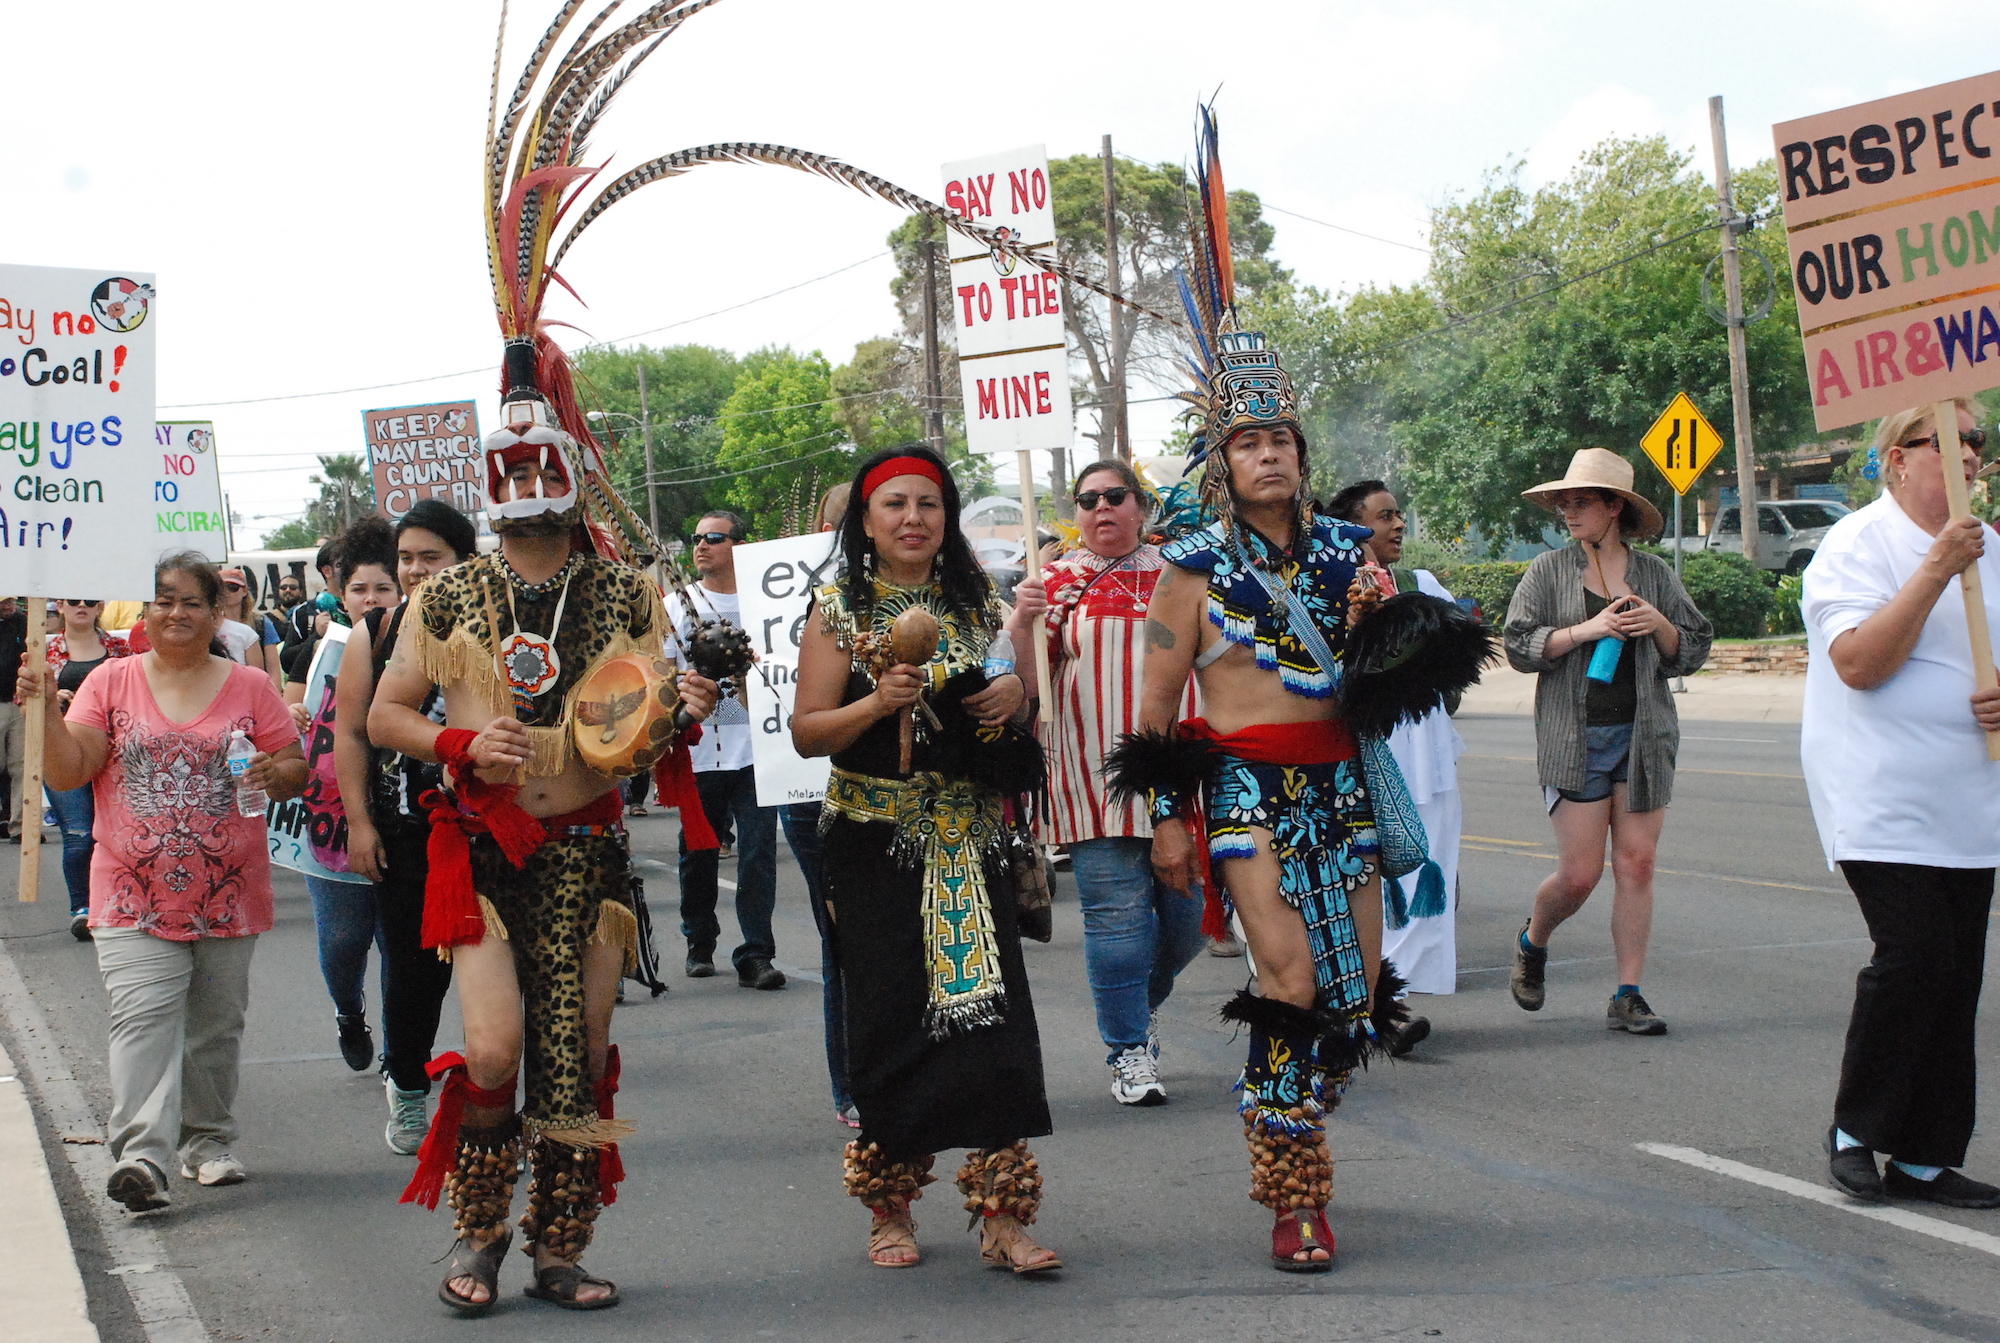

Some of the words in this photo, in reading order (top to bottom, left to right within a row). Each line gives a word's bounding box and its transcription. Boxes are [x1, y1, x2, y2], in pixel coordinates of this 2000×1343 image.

[945, 173, 995, 221] SAY
[1008, 168, 1046, 215] NO
[1796, 234, 1891, 305] OUR
[957, 281, 993, 328] TO
[1000, 272, 1059, 321] THE
[53, 311, 96, 336] no
[22, 345, 128, 394] Coal!
[976, 371, 1052, 420] MINE
[50, 415, 123, 470] yes
[374, 413, 441, 441] KEEP
[163, 454, 195, 476] NO
[370, 434, 482, 466] MAVERICK
[14, 474, 104, 503] Clean
[386, 456, 485, 487] COUNTY
